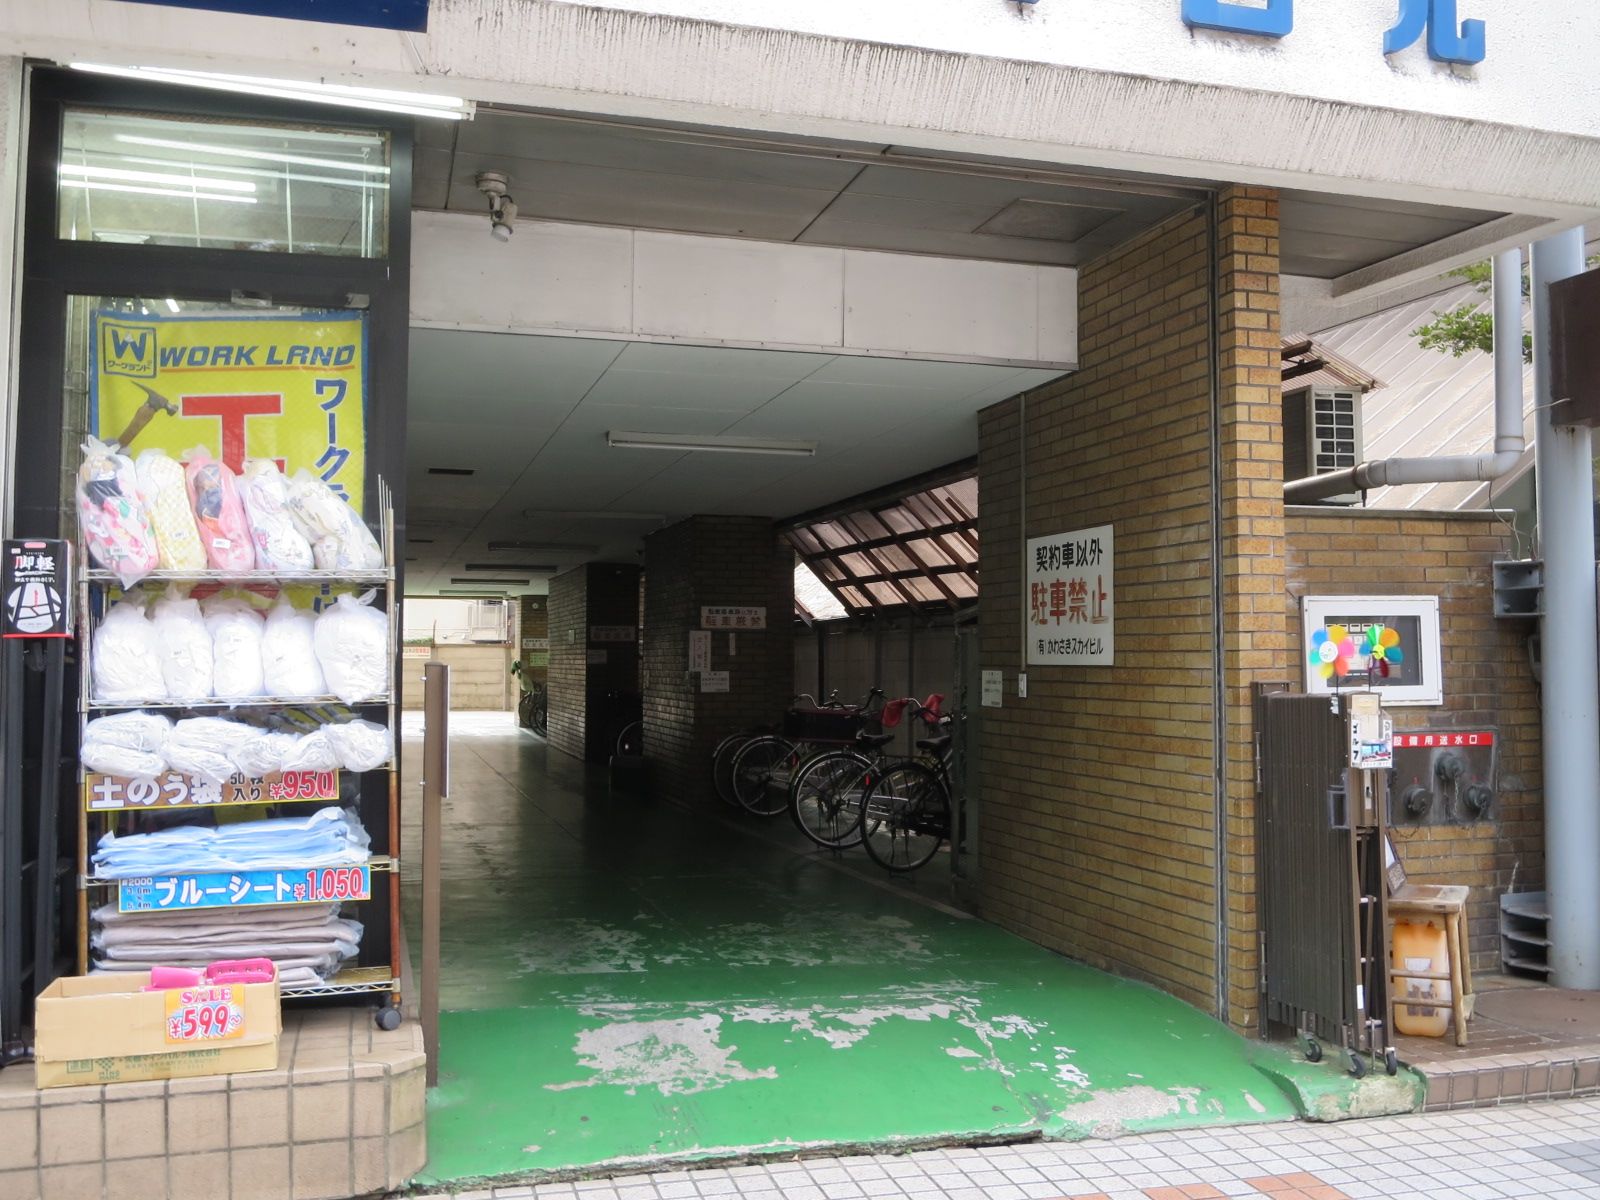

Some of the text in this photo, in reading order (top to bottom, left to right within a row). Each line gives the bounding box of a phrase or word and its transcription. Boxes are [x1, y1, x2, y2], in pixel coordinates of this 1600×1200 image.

[160, 344, 260, 368] WORK
[1036, 537, 1103, 573] 契約車以外
[1030, 574, 1110, 626] 駐車禁止
[232, 787, 260, 801] 入り
[155, 874, 291, 906] ブルーシート
[181, 984, 232, 1004] SALE
